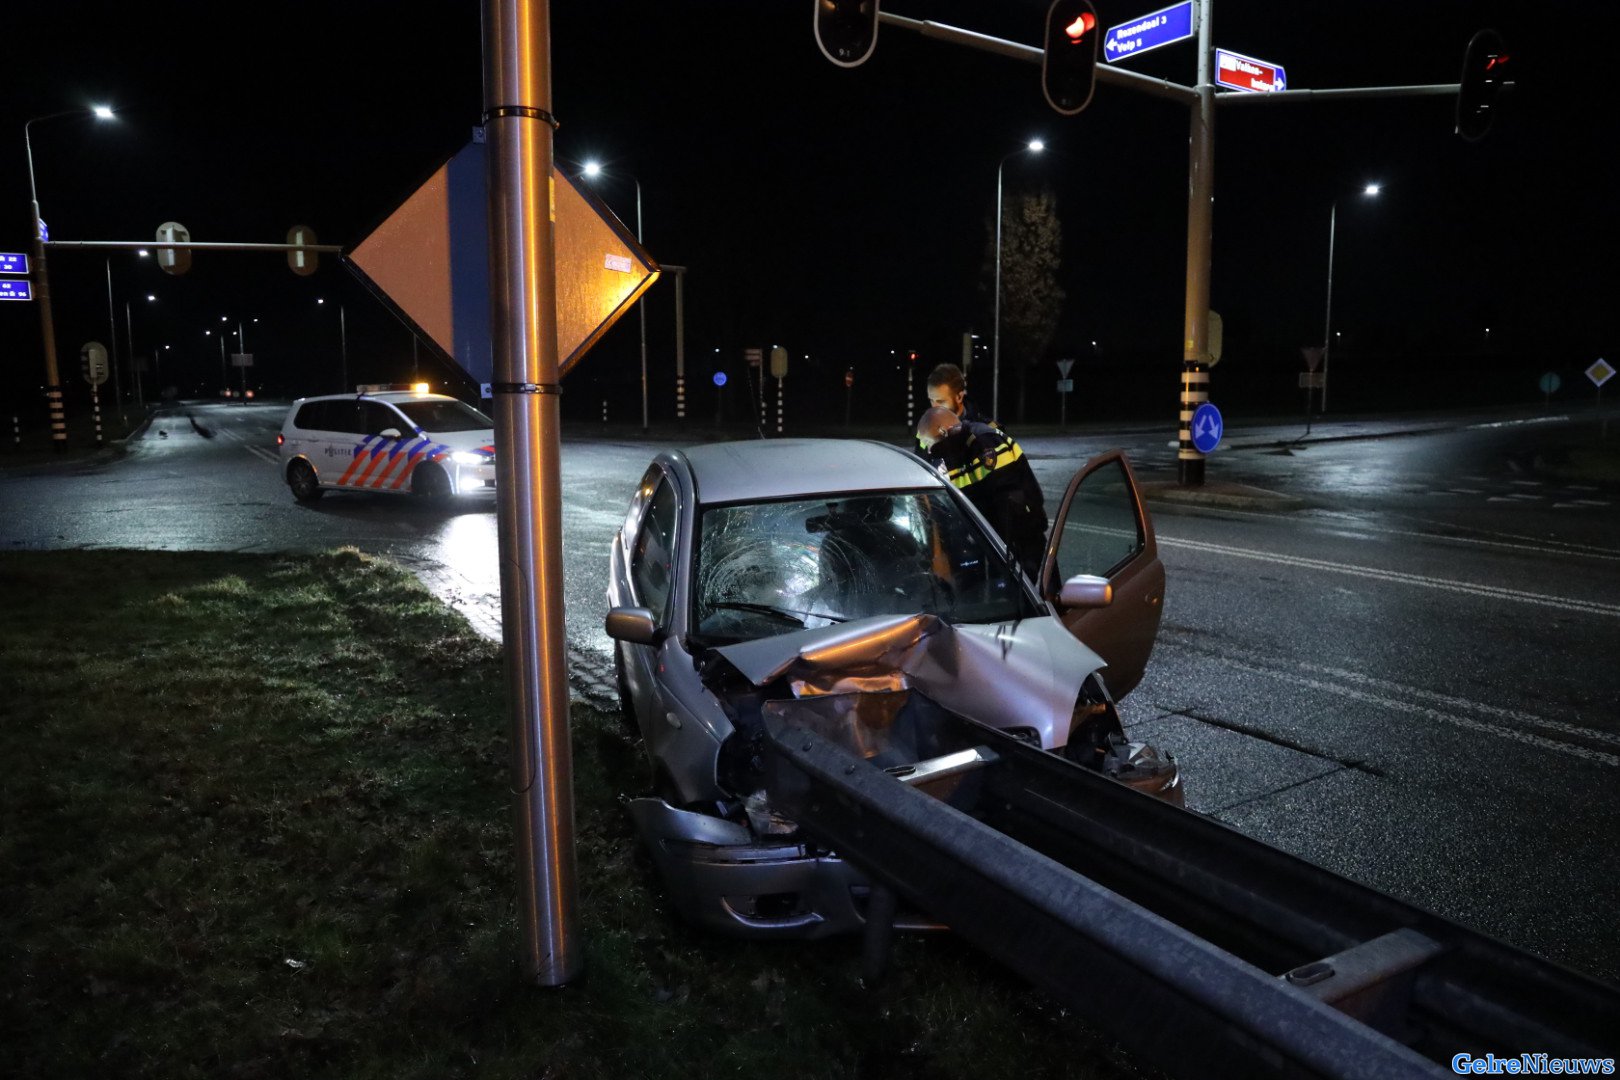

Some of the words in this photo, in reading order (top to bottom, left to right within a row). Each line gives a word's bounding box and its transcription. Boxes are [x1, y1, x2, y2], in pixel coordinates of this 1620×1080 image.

[1117, 16, 1159, 39] Rozendaal
[1161, 15, 1167, 24] 3
[1117, 40, 1135, 53] Velp
